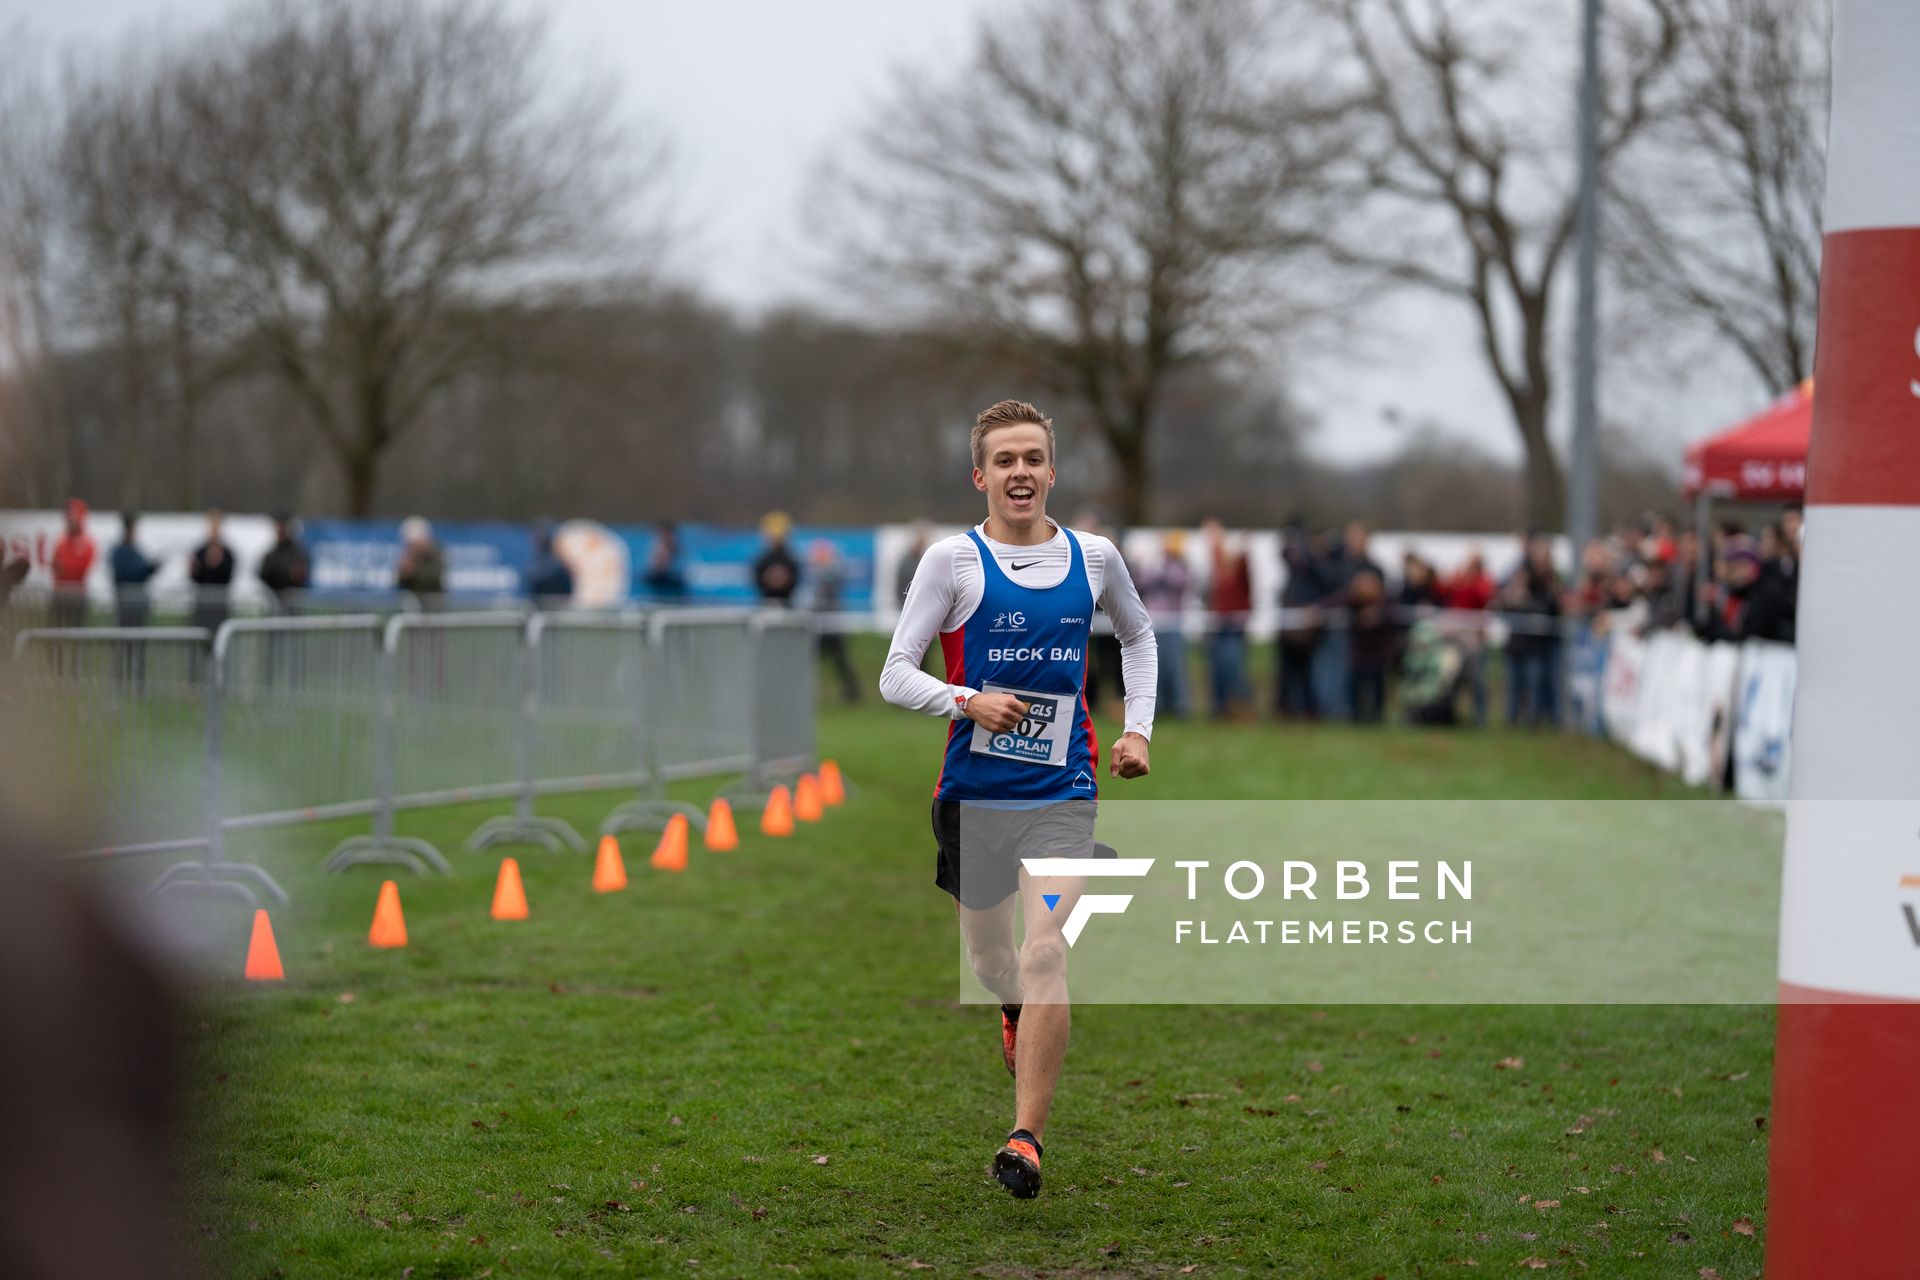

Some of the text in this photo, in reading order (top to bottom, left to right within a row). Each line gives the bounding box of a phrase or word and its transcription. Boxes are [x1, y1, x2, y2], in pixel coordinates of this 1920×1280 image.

[988, 648, 1080, 662] BECK BAU
[1029, 704, 1053, 718] GLS
[1009, 718, 1048, 739] 07
[1016, 739, 1050, 754] PLAN
[1014, 750, 1048, 759] INTERNATIONAL
